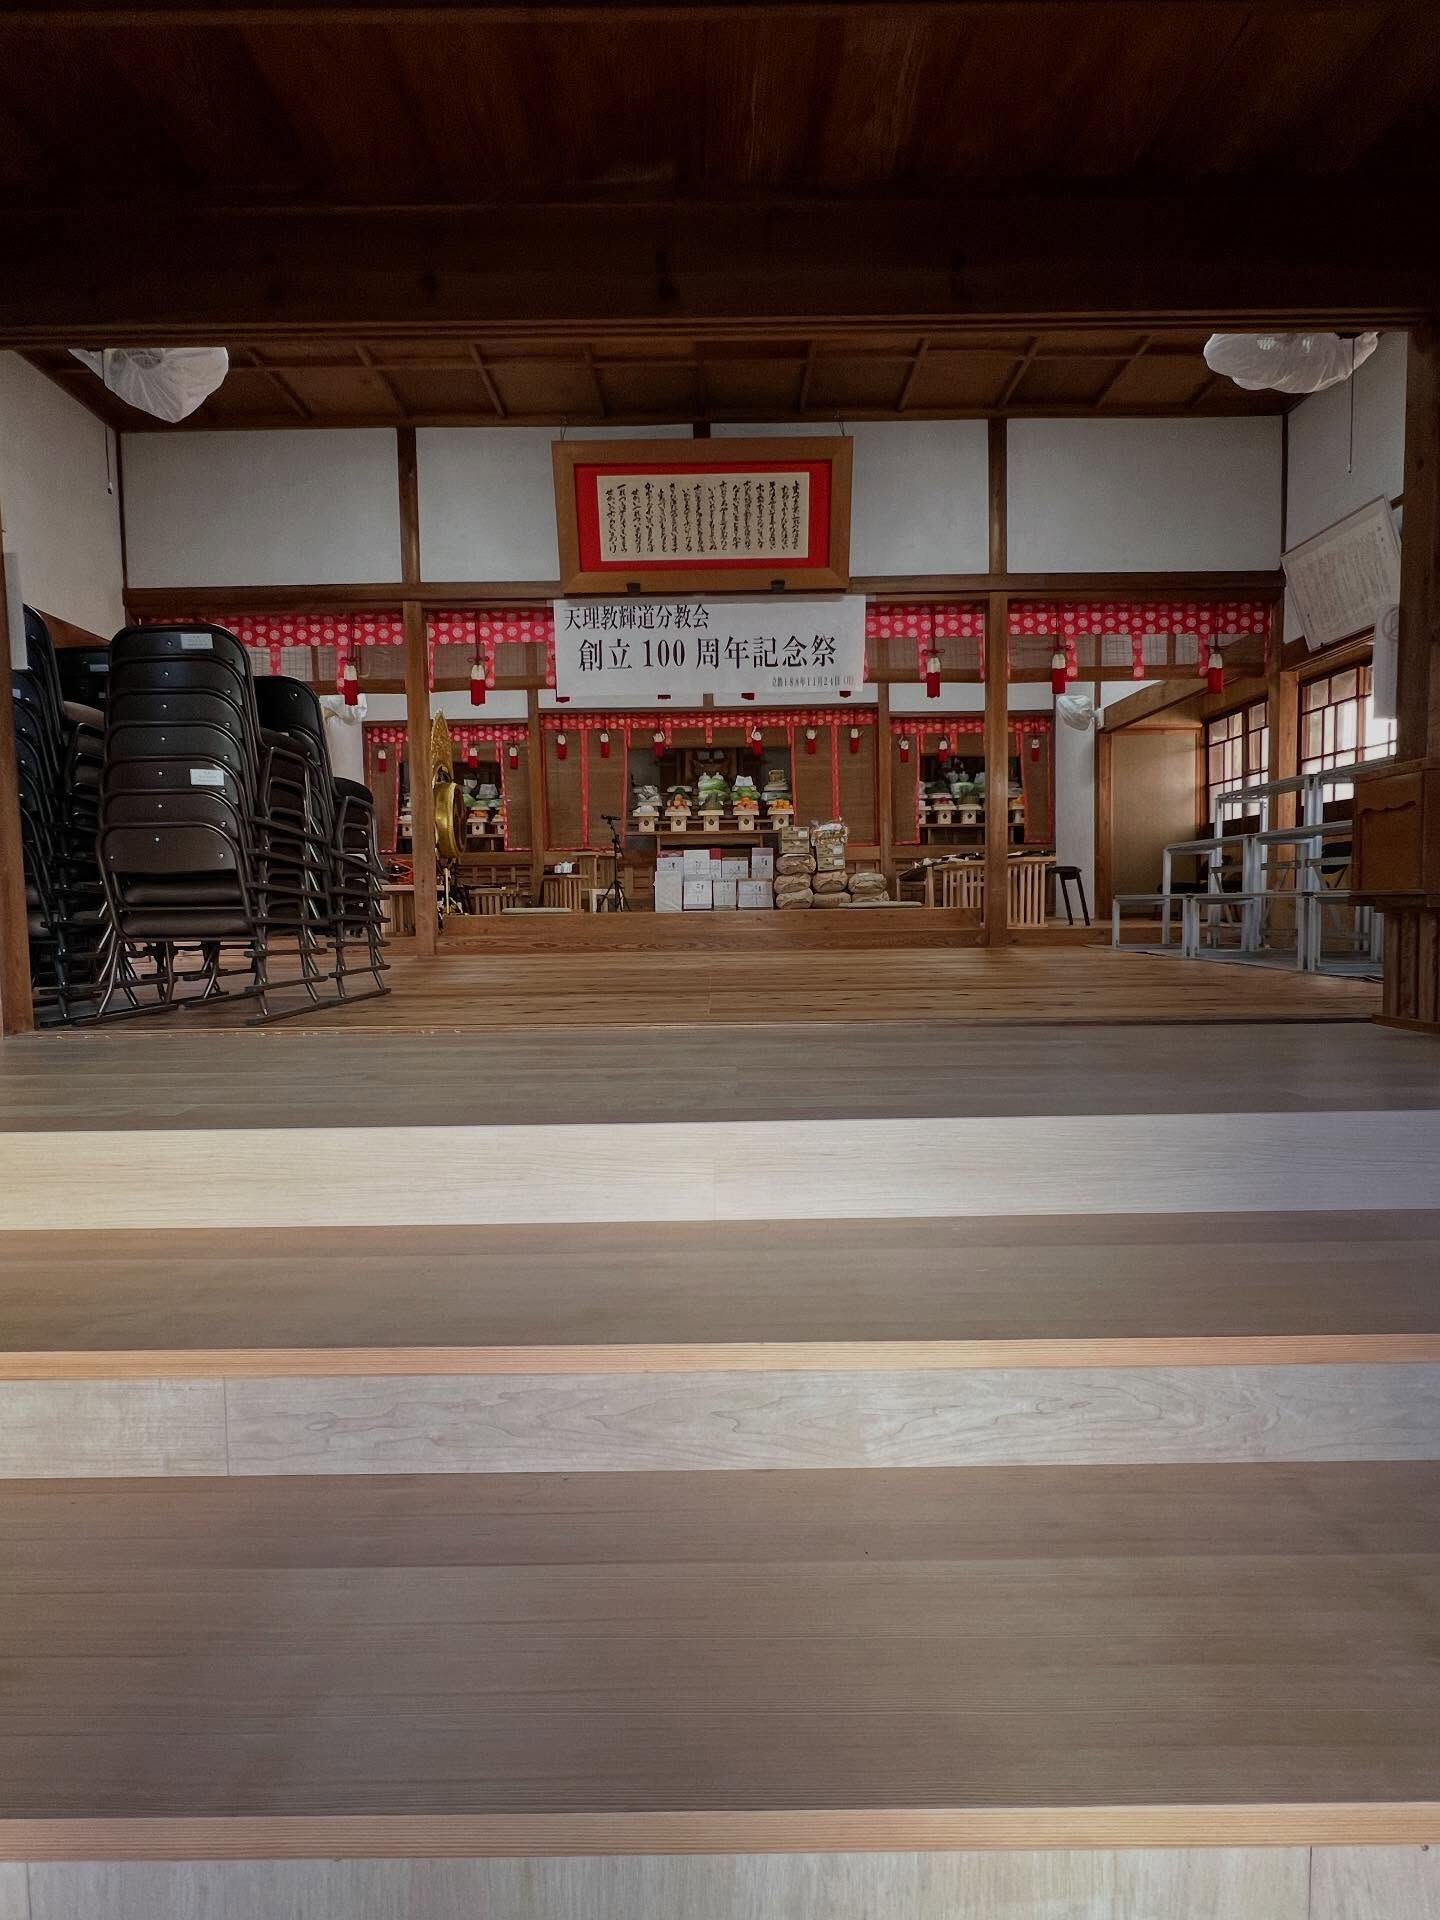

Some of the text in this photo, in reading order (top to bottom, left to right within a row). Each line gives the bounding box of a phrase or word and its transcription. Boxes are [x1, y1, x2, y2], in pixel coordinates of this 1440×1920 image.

[564, 603, 710, 631] 天理教輝道分教会
